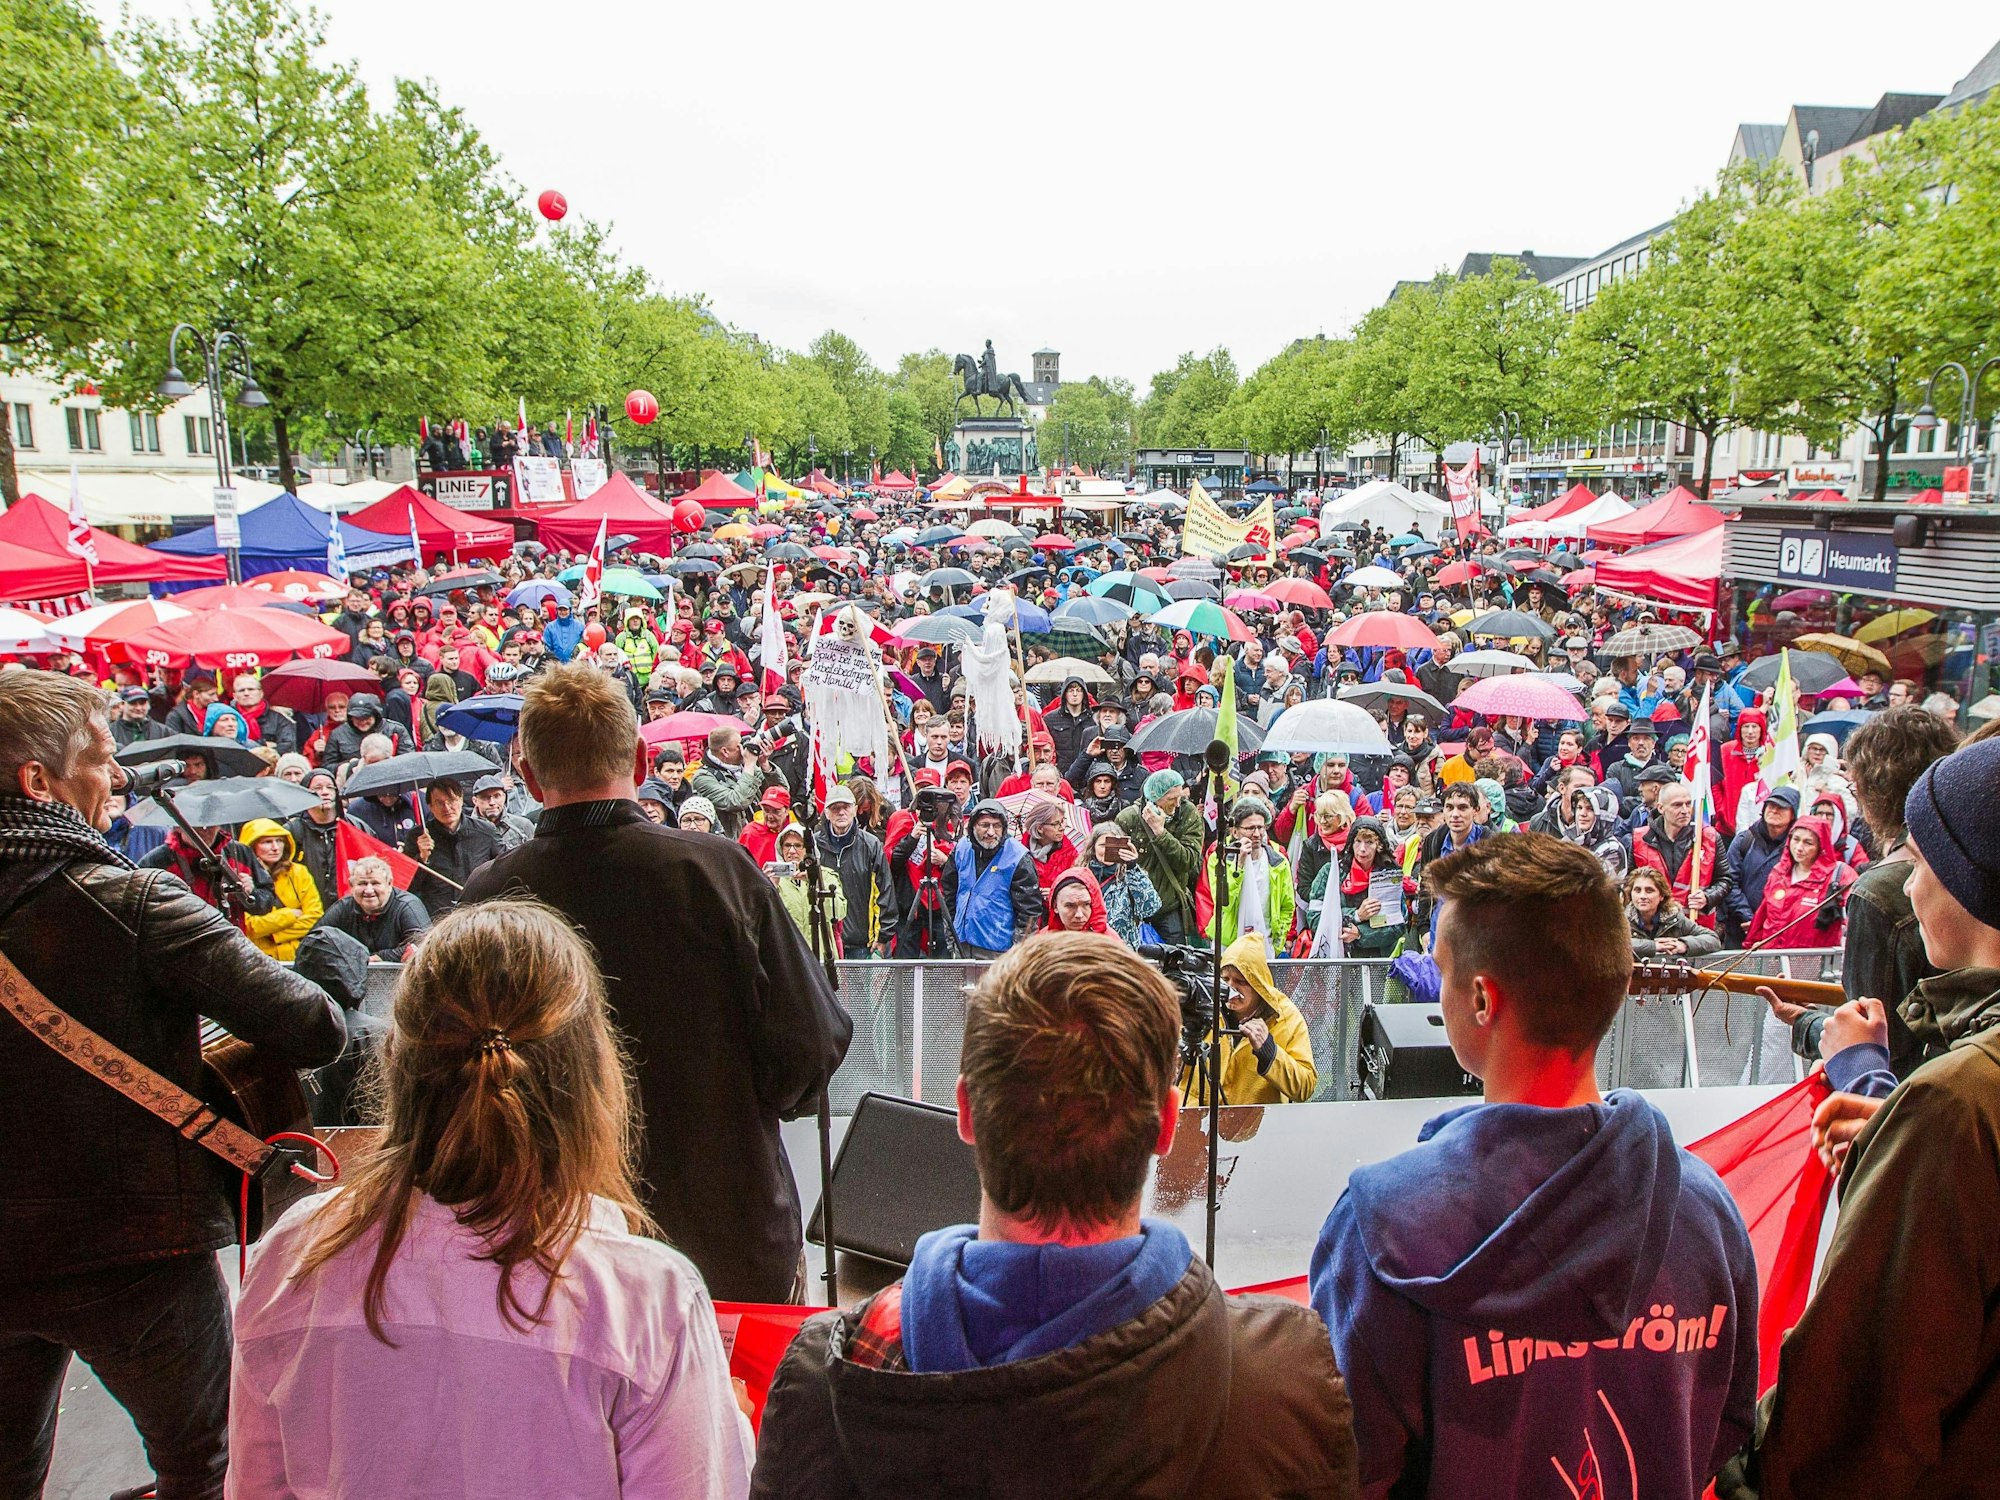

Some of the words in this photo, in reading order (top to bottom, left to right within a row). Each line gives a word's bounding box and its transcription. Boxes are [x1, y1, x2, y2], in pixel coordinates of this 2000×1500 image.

[1829, 550, 1891, 575] Heumarkt
[312, 643, 332, 658] SPD
[816, 639, 850, 653] Schluss
[146, 649, 170, 667] SPD
[225, 652, 259, 668] SPD
[838, 653, 852, 665] bei
